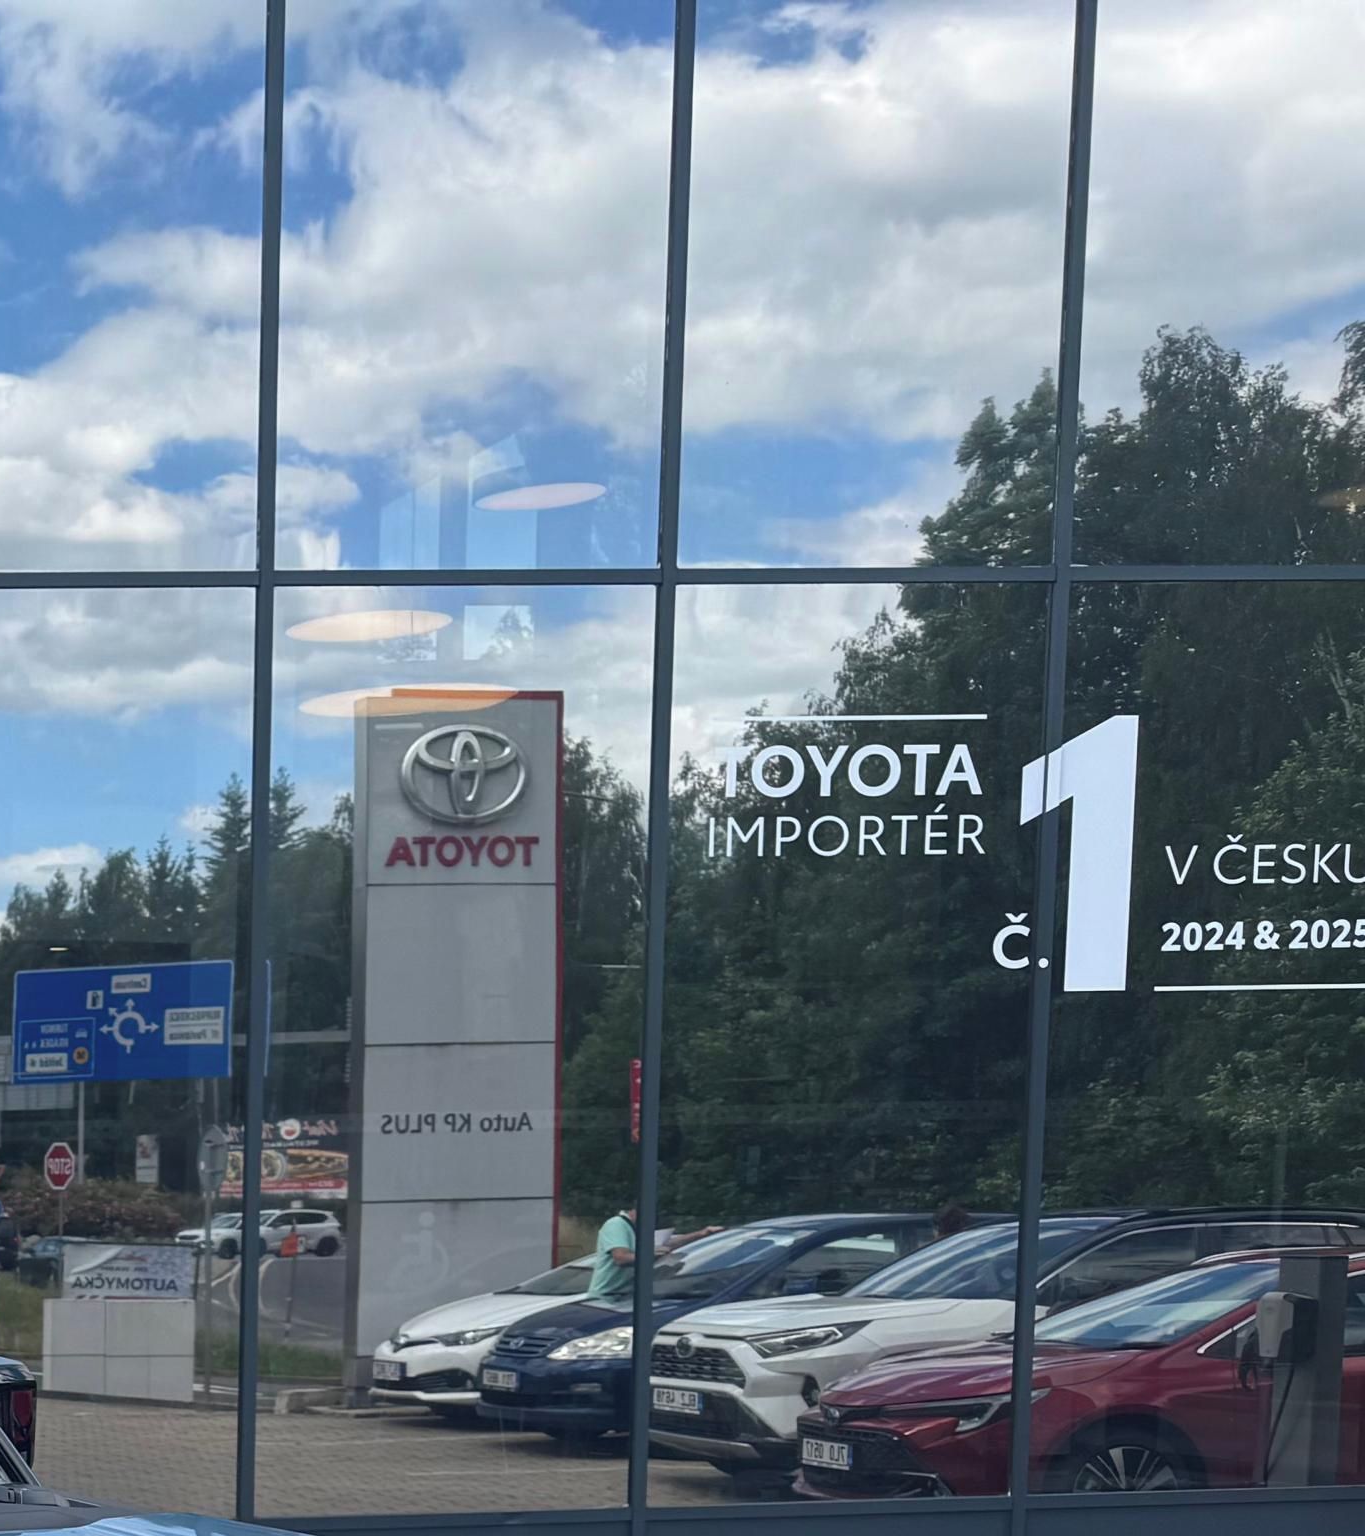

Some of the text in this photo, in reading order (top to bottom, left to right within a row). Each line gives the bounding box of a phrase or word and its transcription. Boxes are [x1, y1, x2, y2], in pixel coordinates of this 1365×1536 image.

[715, 743, 983, 799] TOYOTA
[707, 802, 986, 858] IMPORTÉR
[992, 714, 1140, 992] Č. 1
[1165, 834, 1365, 886] V ČESKU
[1160, 919, 1365, 952] 2024 & 2025
